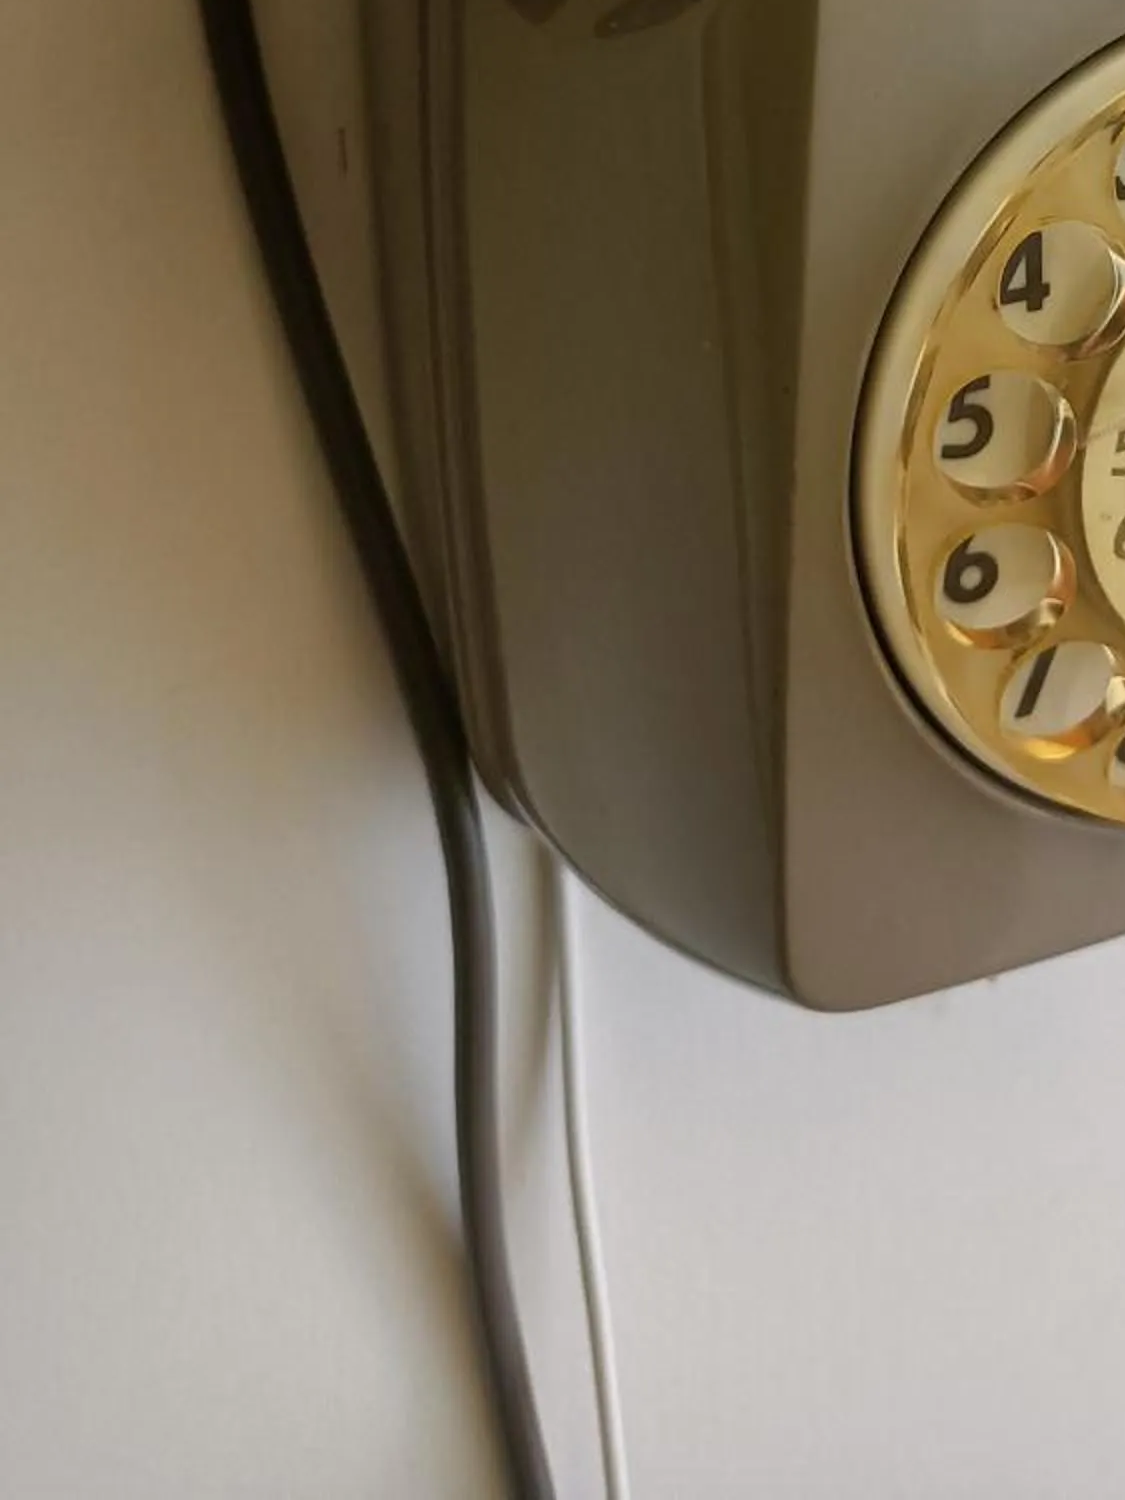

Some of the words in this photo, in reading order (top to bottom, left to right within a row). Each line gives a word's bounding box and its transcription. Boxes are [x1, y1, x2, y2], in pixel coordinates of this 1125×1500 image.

[1000, 231, 1050, 312] 4
[940, 374, 994, 460] 5
[943, 533, 999, 603] 6
